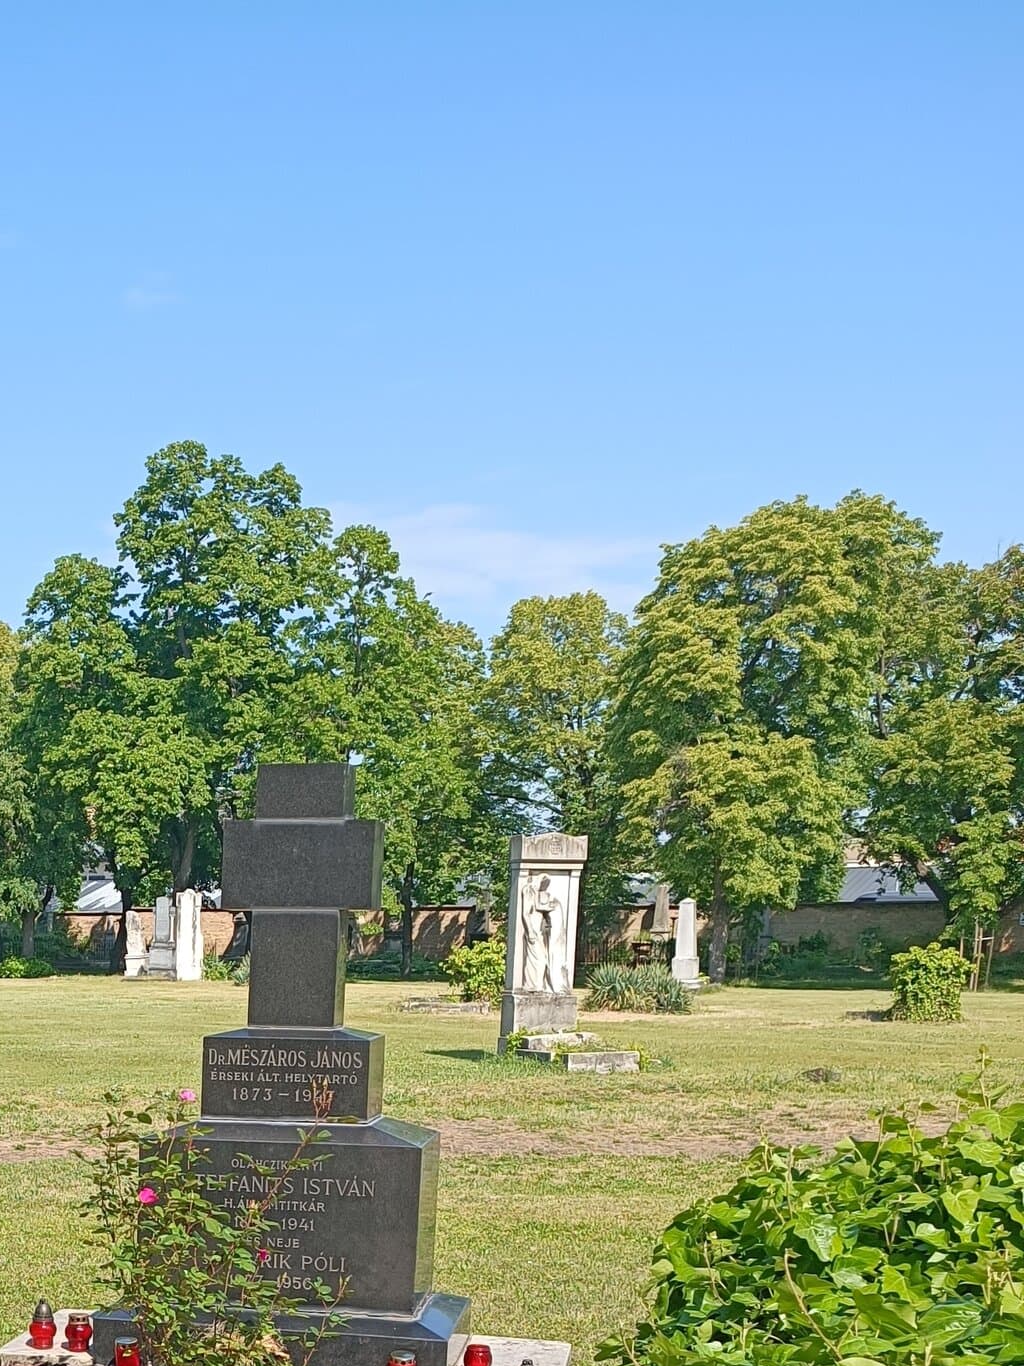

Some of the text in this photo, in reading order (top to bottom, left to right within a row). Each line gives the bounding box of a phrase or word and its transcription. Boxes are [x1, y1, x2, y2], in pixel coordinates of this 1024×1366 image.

[310, 1046, 363, 1069] JÁNOS
[211, 1068, 358, 1085] ÉRSEKI ÁLT. HELYTARTÓ
[232, 1087, 273, 1101] 1873
[303, 1175, 375, 1197] ISTVÁN
[282, 1217, 315, 1232] 1941
[266, 1237, 300, 1249] NEJE
[301, 1251, 346, 1273] PÓLI
